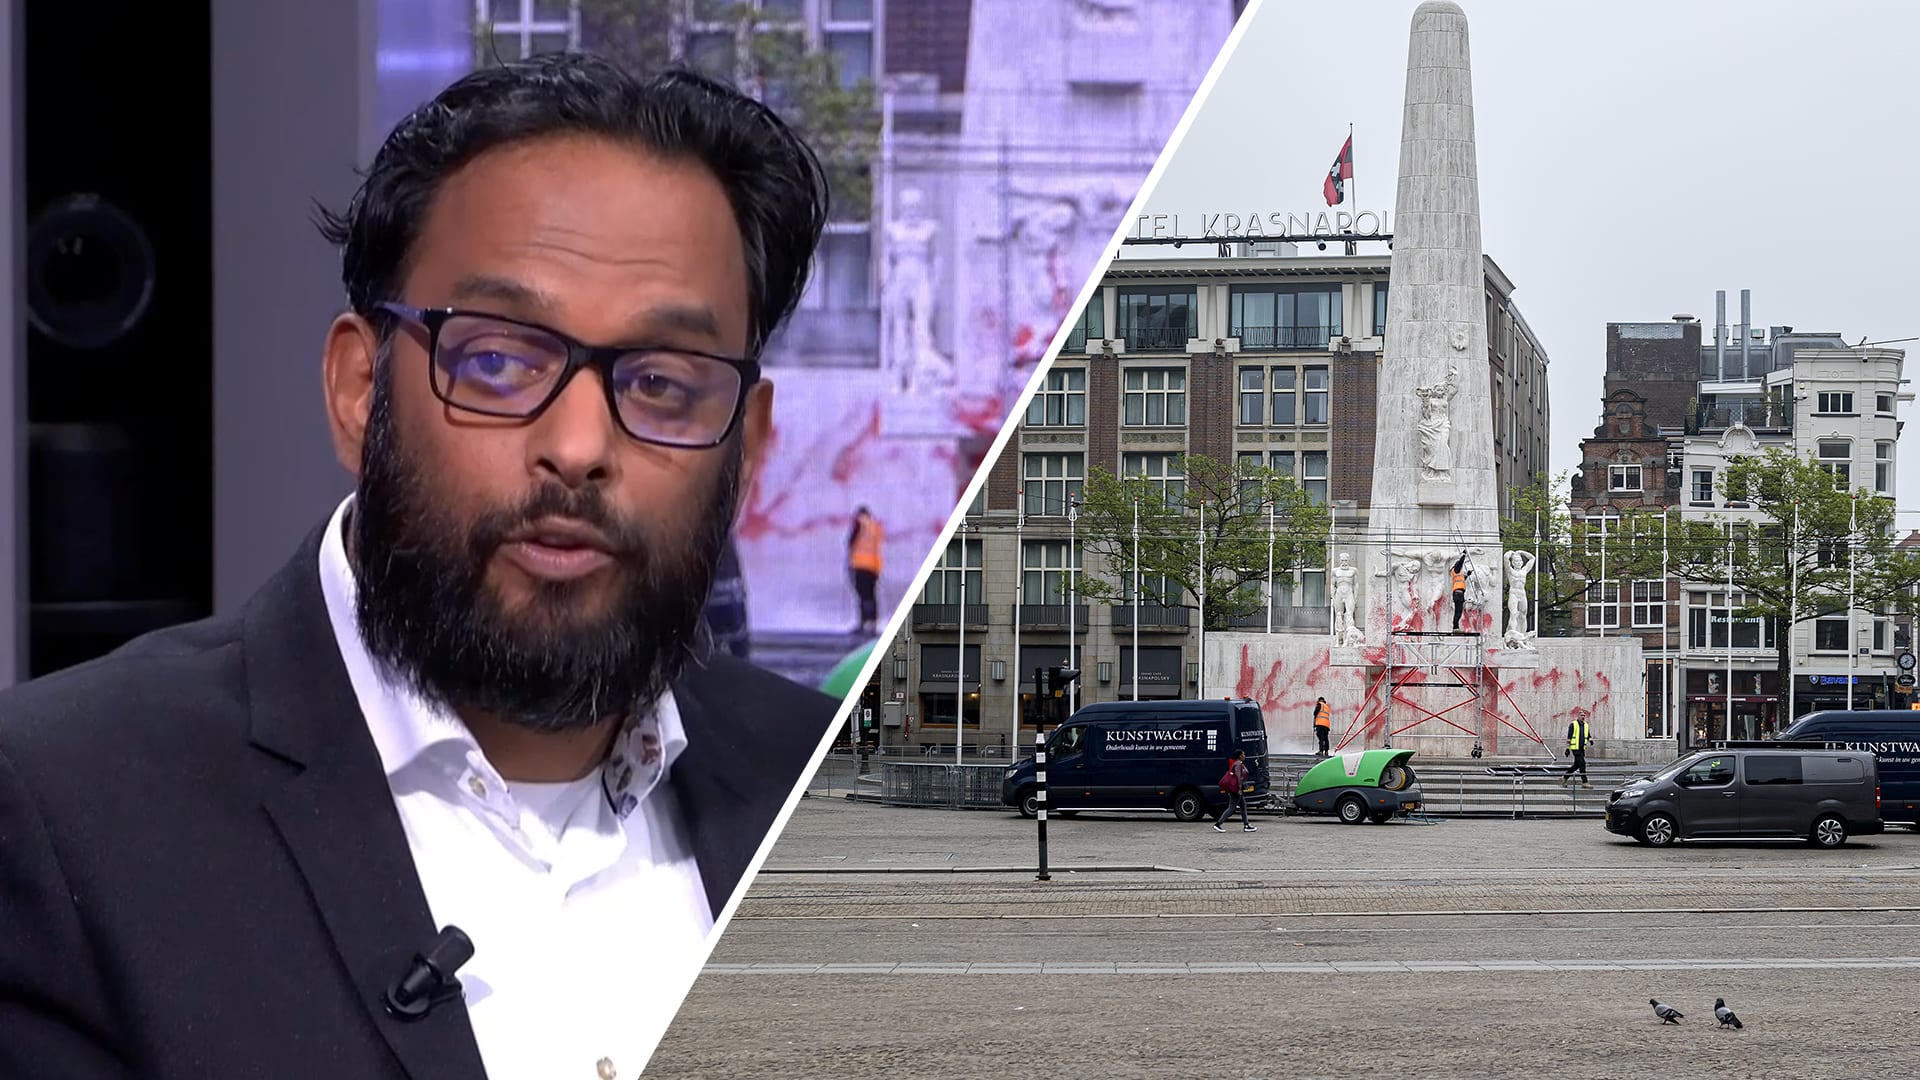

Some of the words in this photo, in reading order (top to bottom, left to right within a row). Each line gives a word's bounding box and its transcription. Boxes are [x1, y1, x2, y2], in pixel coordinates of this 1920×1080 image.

[1202, 211, 1394, 238] KRASNAPOL
[1820, 675, 1859, 686] Bavara
[1106, 730, 1203, 741] KUNSTWACHT
